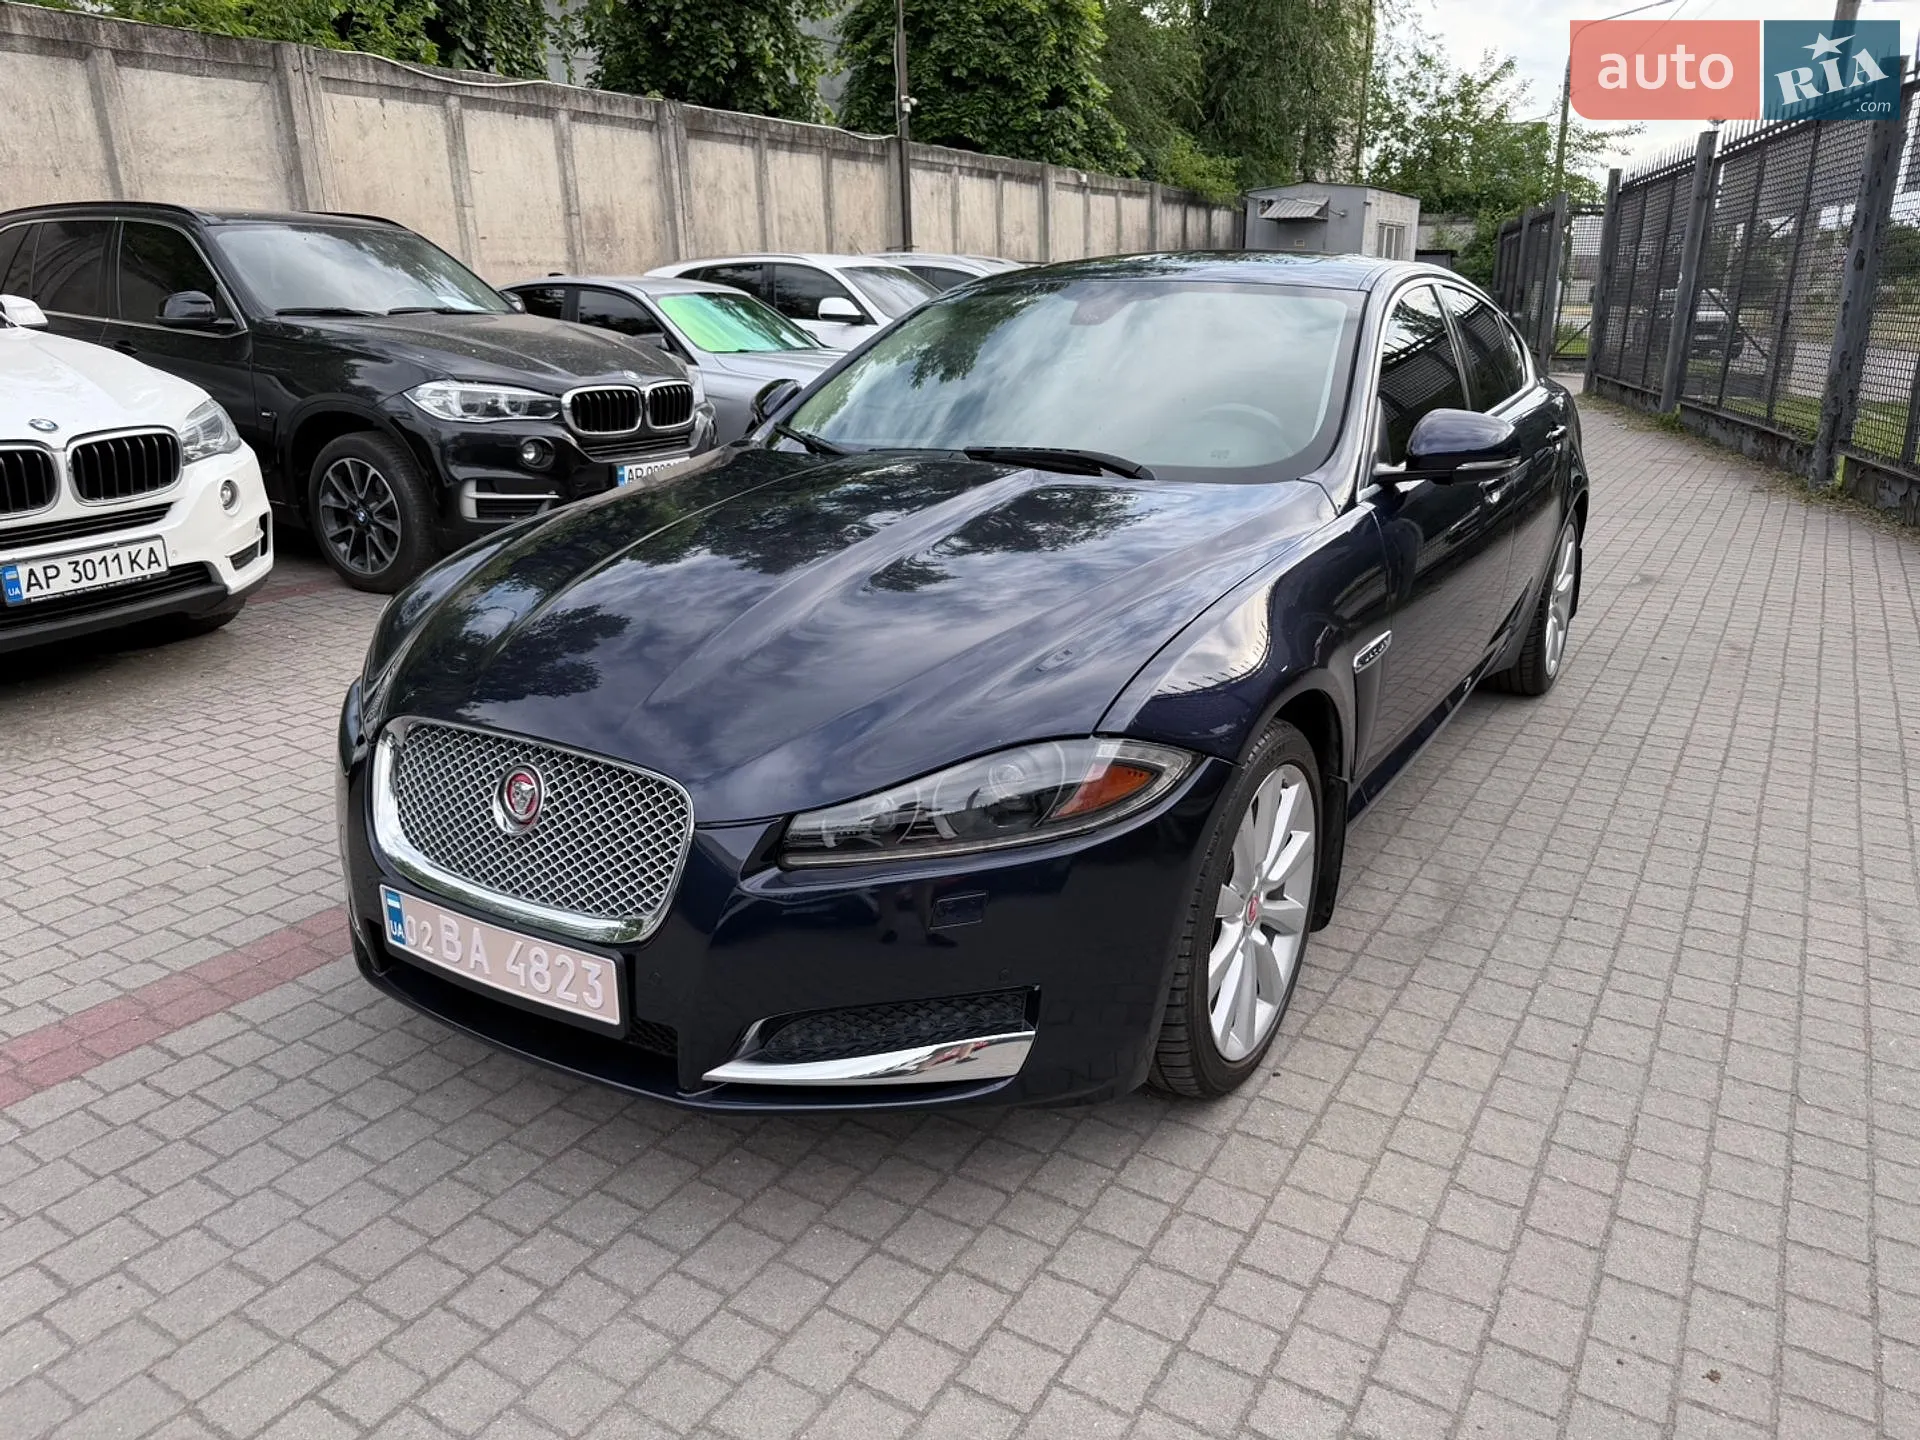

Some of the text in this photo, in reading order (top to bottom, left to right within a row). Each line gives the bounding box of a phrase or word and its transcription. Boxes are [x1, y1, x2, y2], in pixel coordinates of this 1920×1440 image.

[26, 564, 61, 593] AP
[67, 553, 124, 584] 3011
[129, 546, 162, 574] KA
[7, 586, 21, 597] UA
[390, 919, 405, 940] UA
[505, 940, 605, 1011] 4823
